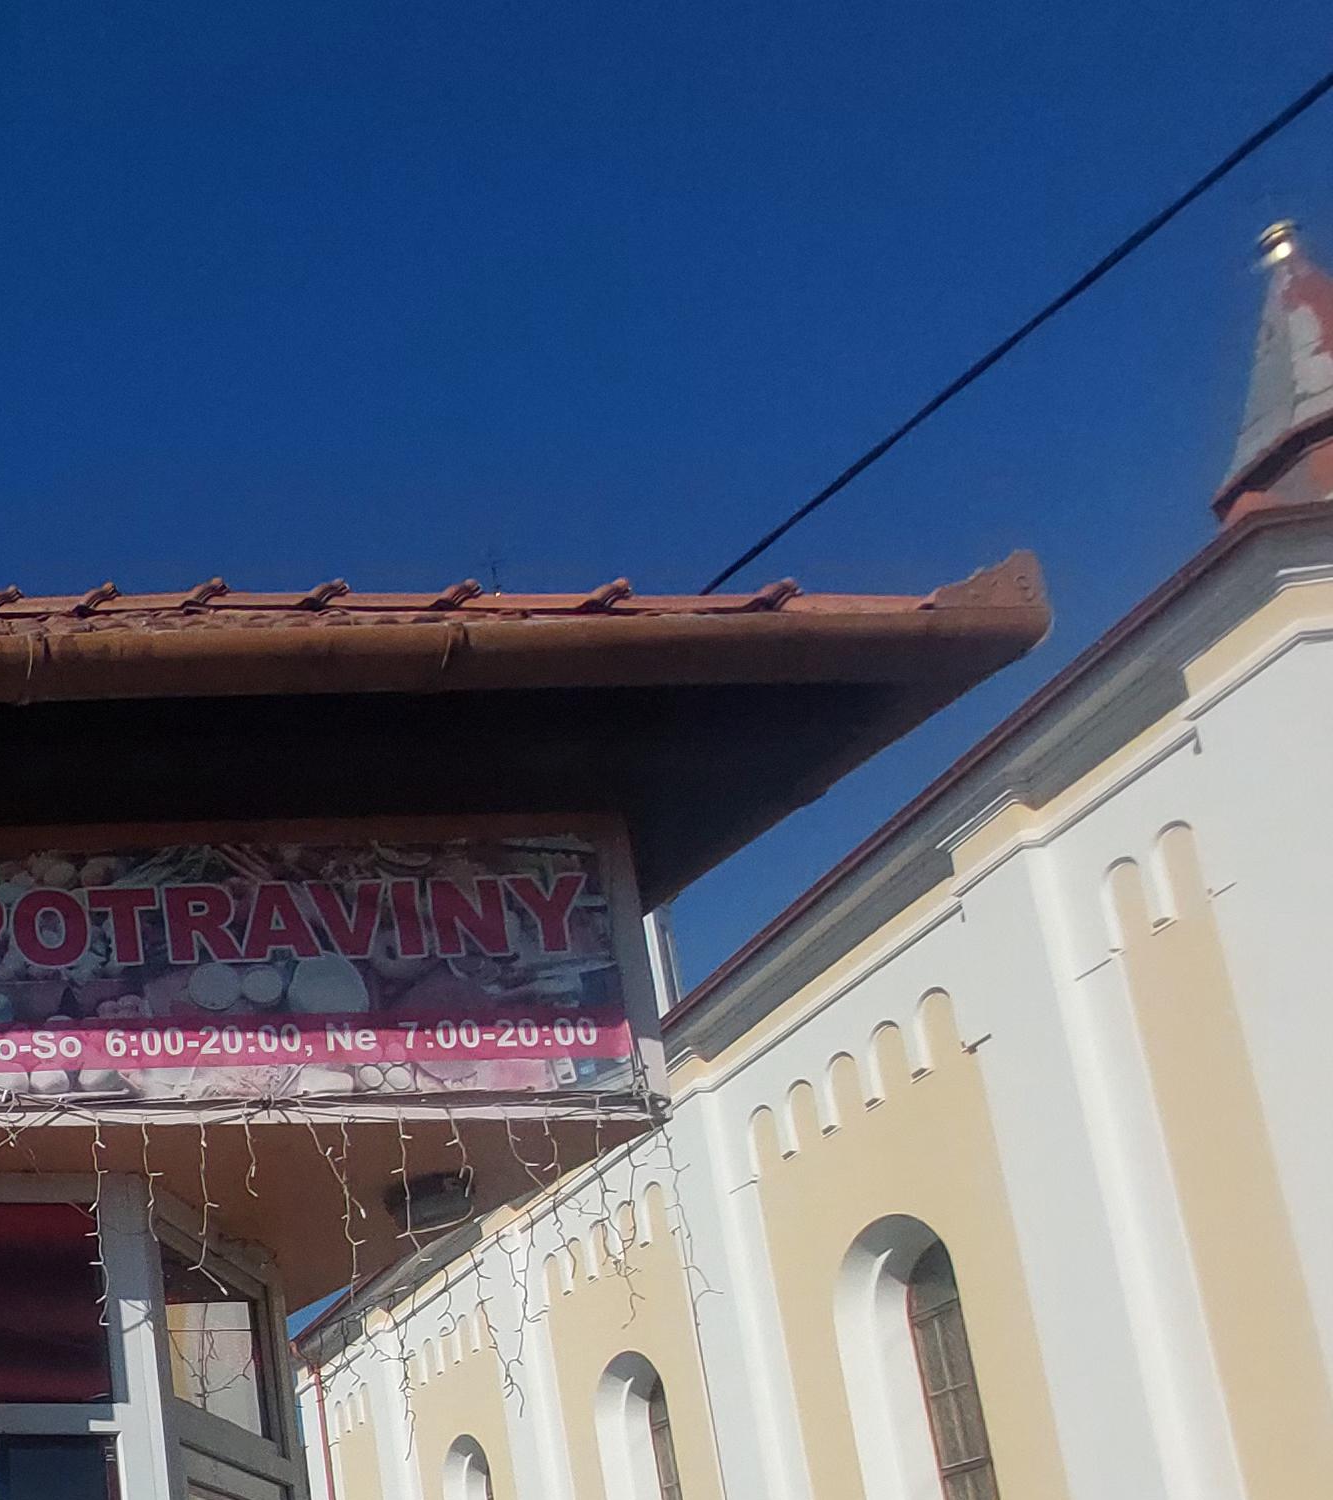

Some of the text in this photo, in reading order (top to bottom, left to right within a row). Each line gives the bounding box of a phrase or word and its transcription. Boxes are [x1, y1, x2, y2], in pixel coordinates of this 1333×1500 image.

[104, 1023, 314, 1057] 6:00-20:00,
[325, 1022, 378, 1052] Ne
[398, 1018, 598, 1050] 7:00-20:00
